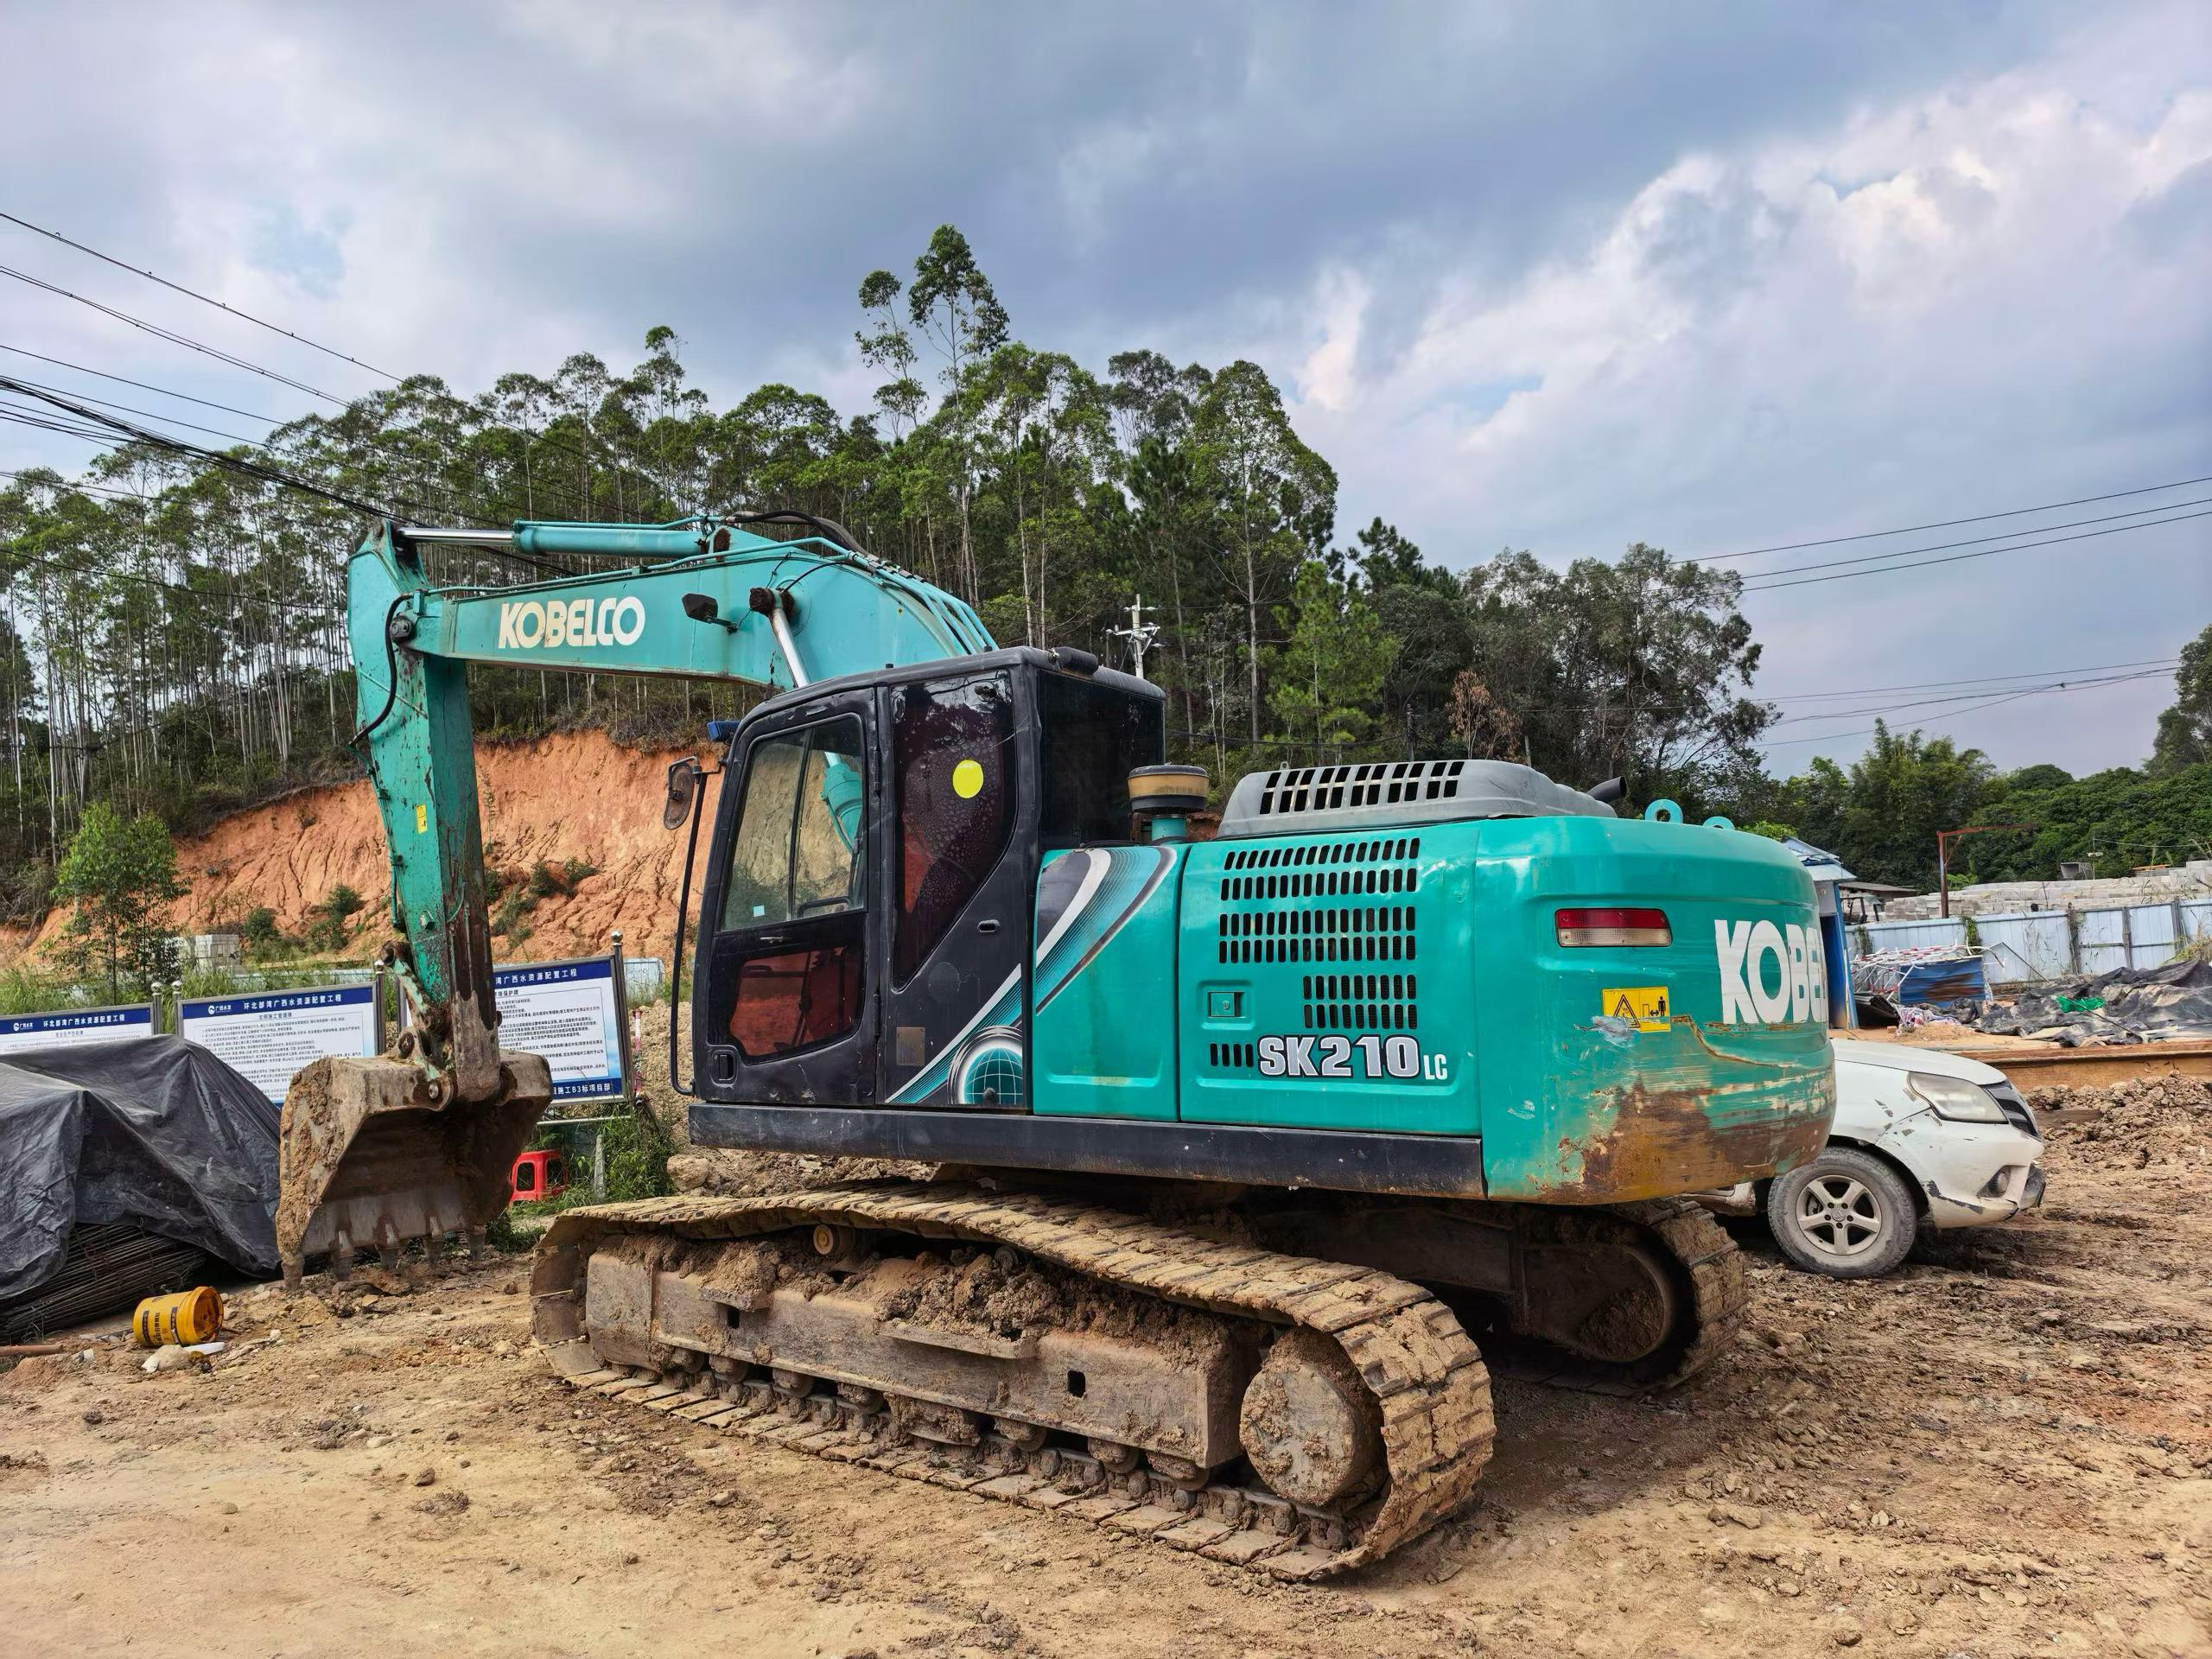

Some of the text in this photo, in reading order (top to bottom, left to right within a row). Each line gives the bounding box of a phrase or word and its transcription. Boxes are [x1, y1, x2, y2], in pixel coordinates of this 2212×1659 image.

[499, 596, 646, 649] KOBELCO
[244, 993, 342, 1010] 环北部湾广西水资源配置工程
[43, 1014, 125, 1028] 环北部湾广西水资源配置工程
[1258, 1033, 1448, 1080] SK210 LC
